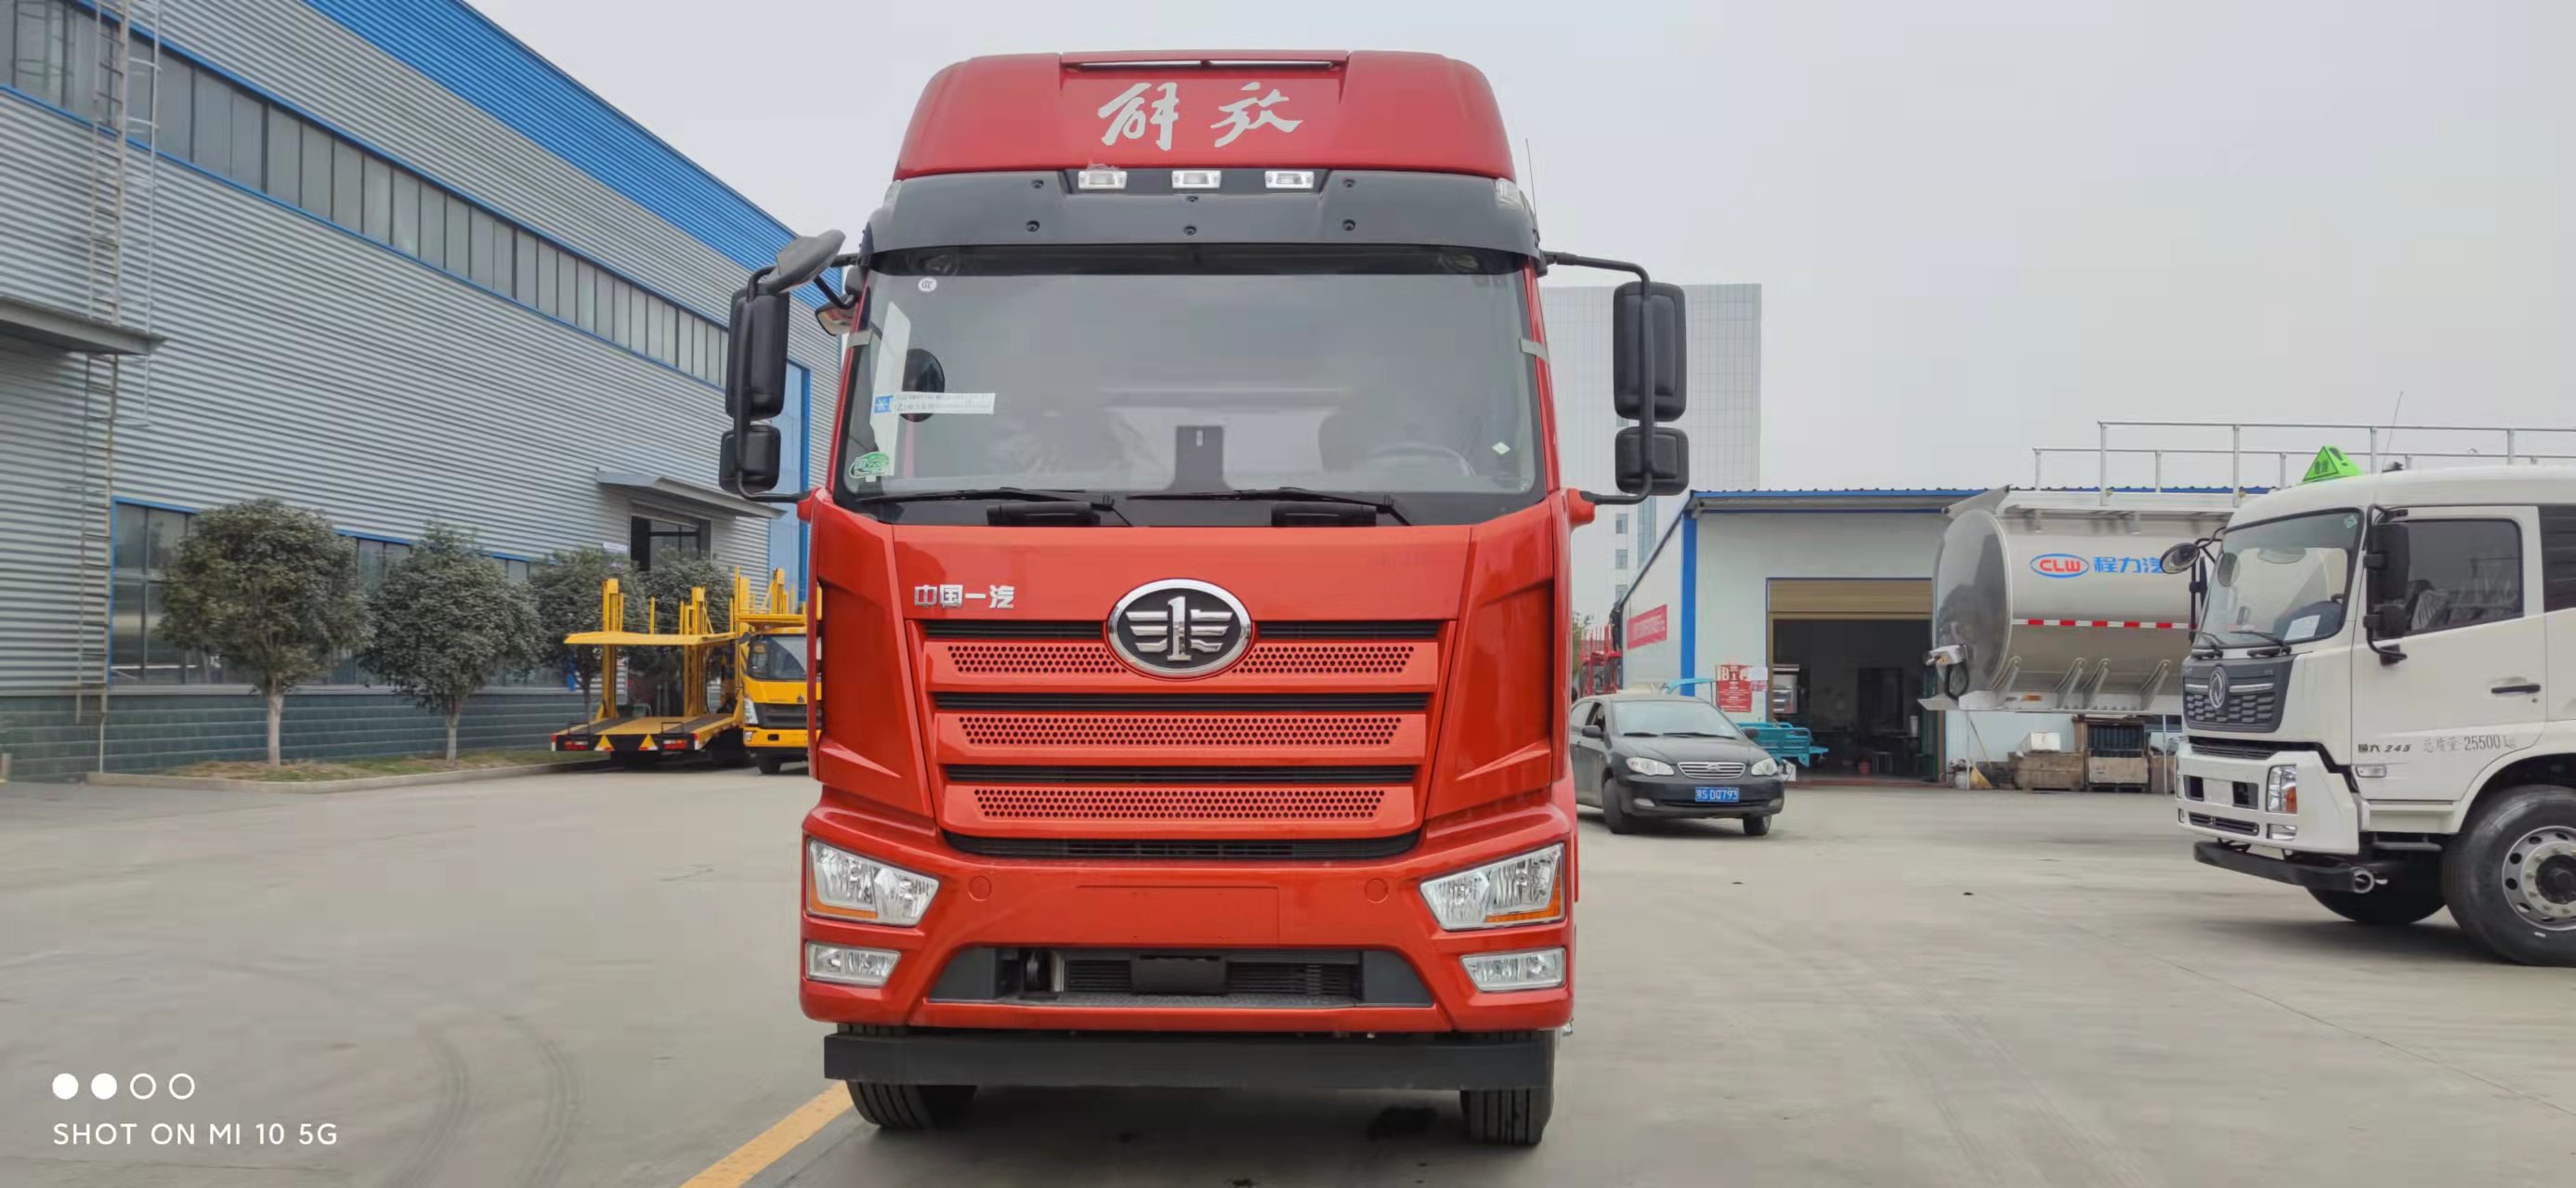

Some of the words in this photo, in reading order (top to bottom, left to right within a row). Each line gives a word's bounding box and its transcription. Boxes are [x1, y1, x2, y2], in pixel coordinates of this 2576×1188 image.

[1097, 82, 1303, 151] 解放
[2039, 559, 2082, 573] CLW
[914, 584, 1015, 609] 中国一汽
